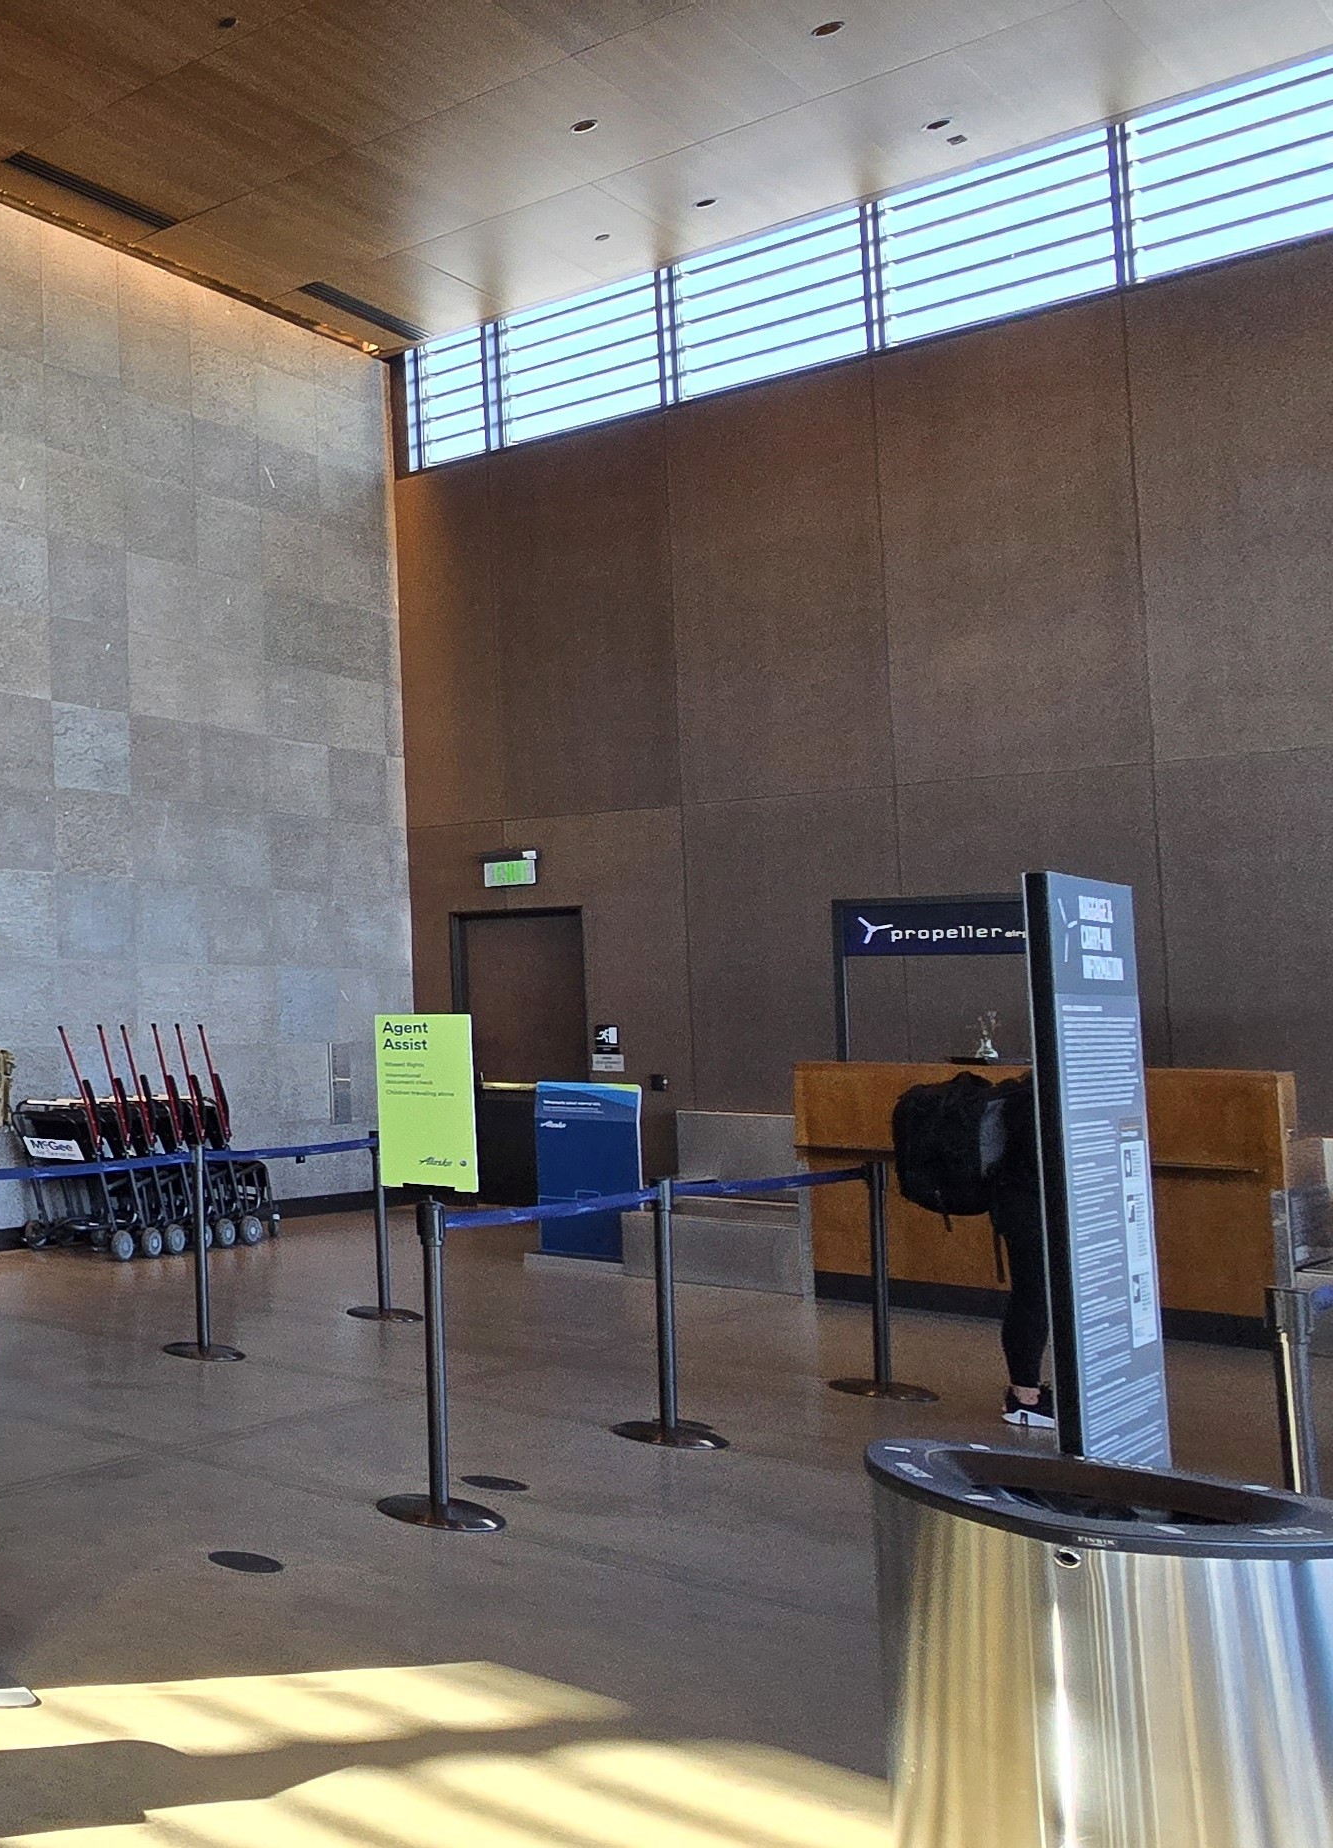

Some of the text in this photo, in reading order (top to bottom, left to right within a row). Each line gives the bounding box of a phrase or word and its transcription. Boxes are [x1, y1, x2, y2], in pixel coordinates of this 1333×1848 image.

[890, 925, 1003, 943] propeller
[382, 1021, 429, 1036] Agent
[382, 1038, 428, 1050] Assist
[29, 1139, 73, 1152] McGee
